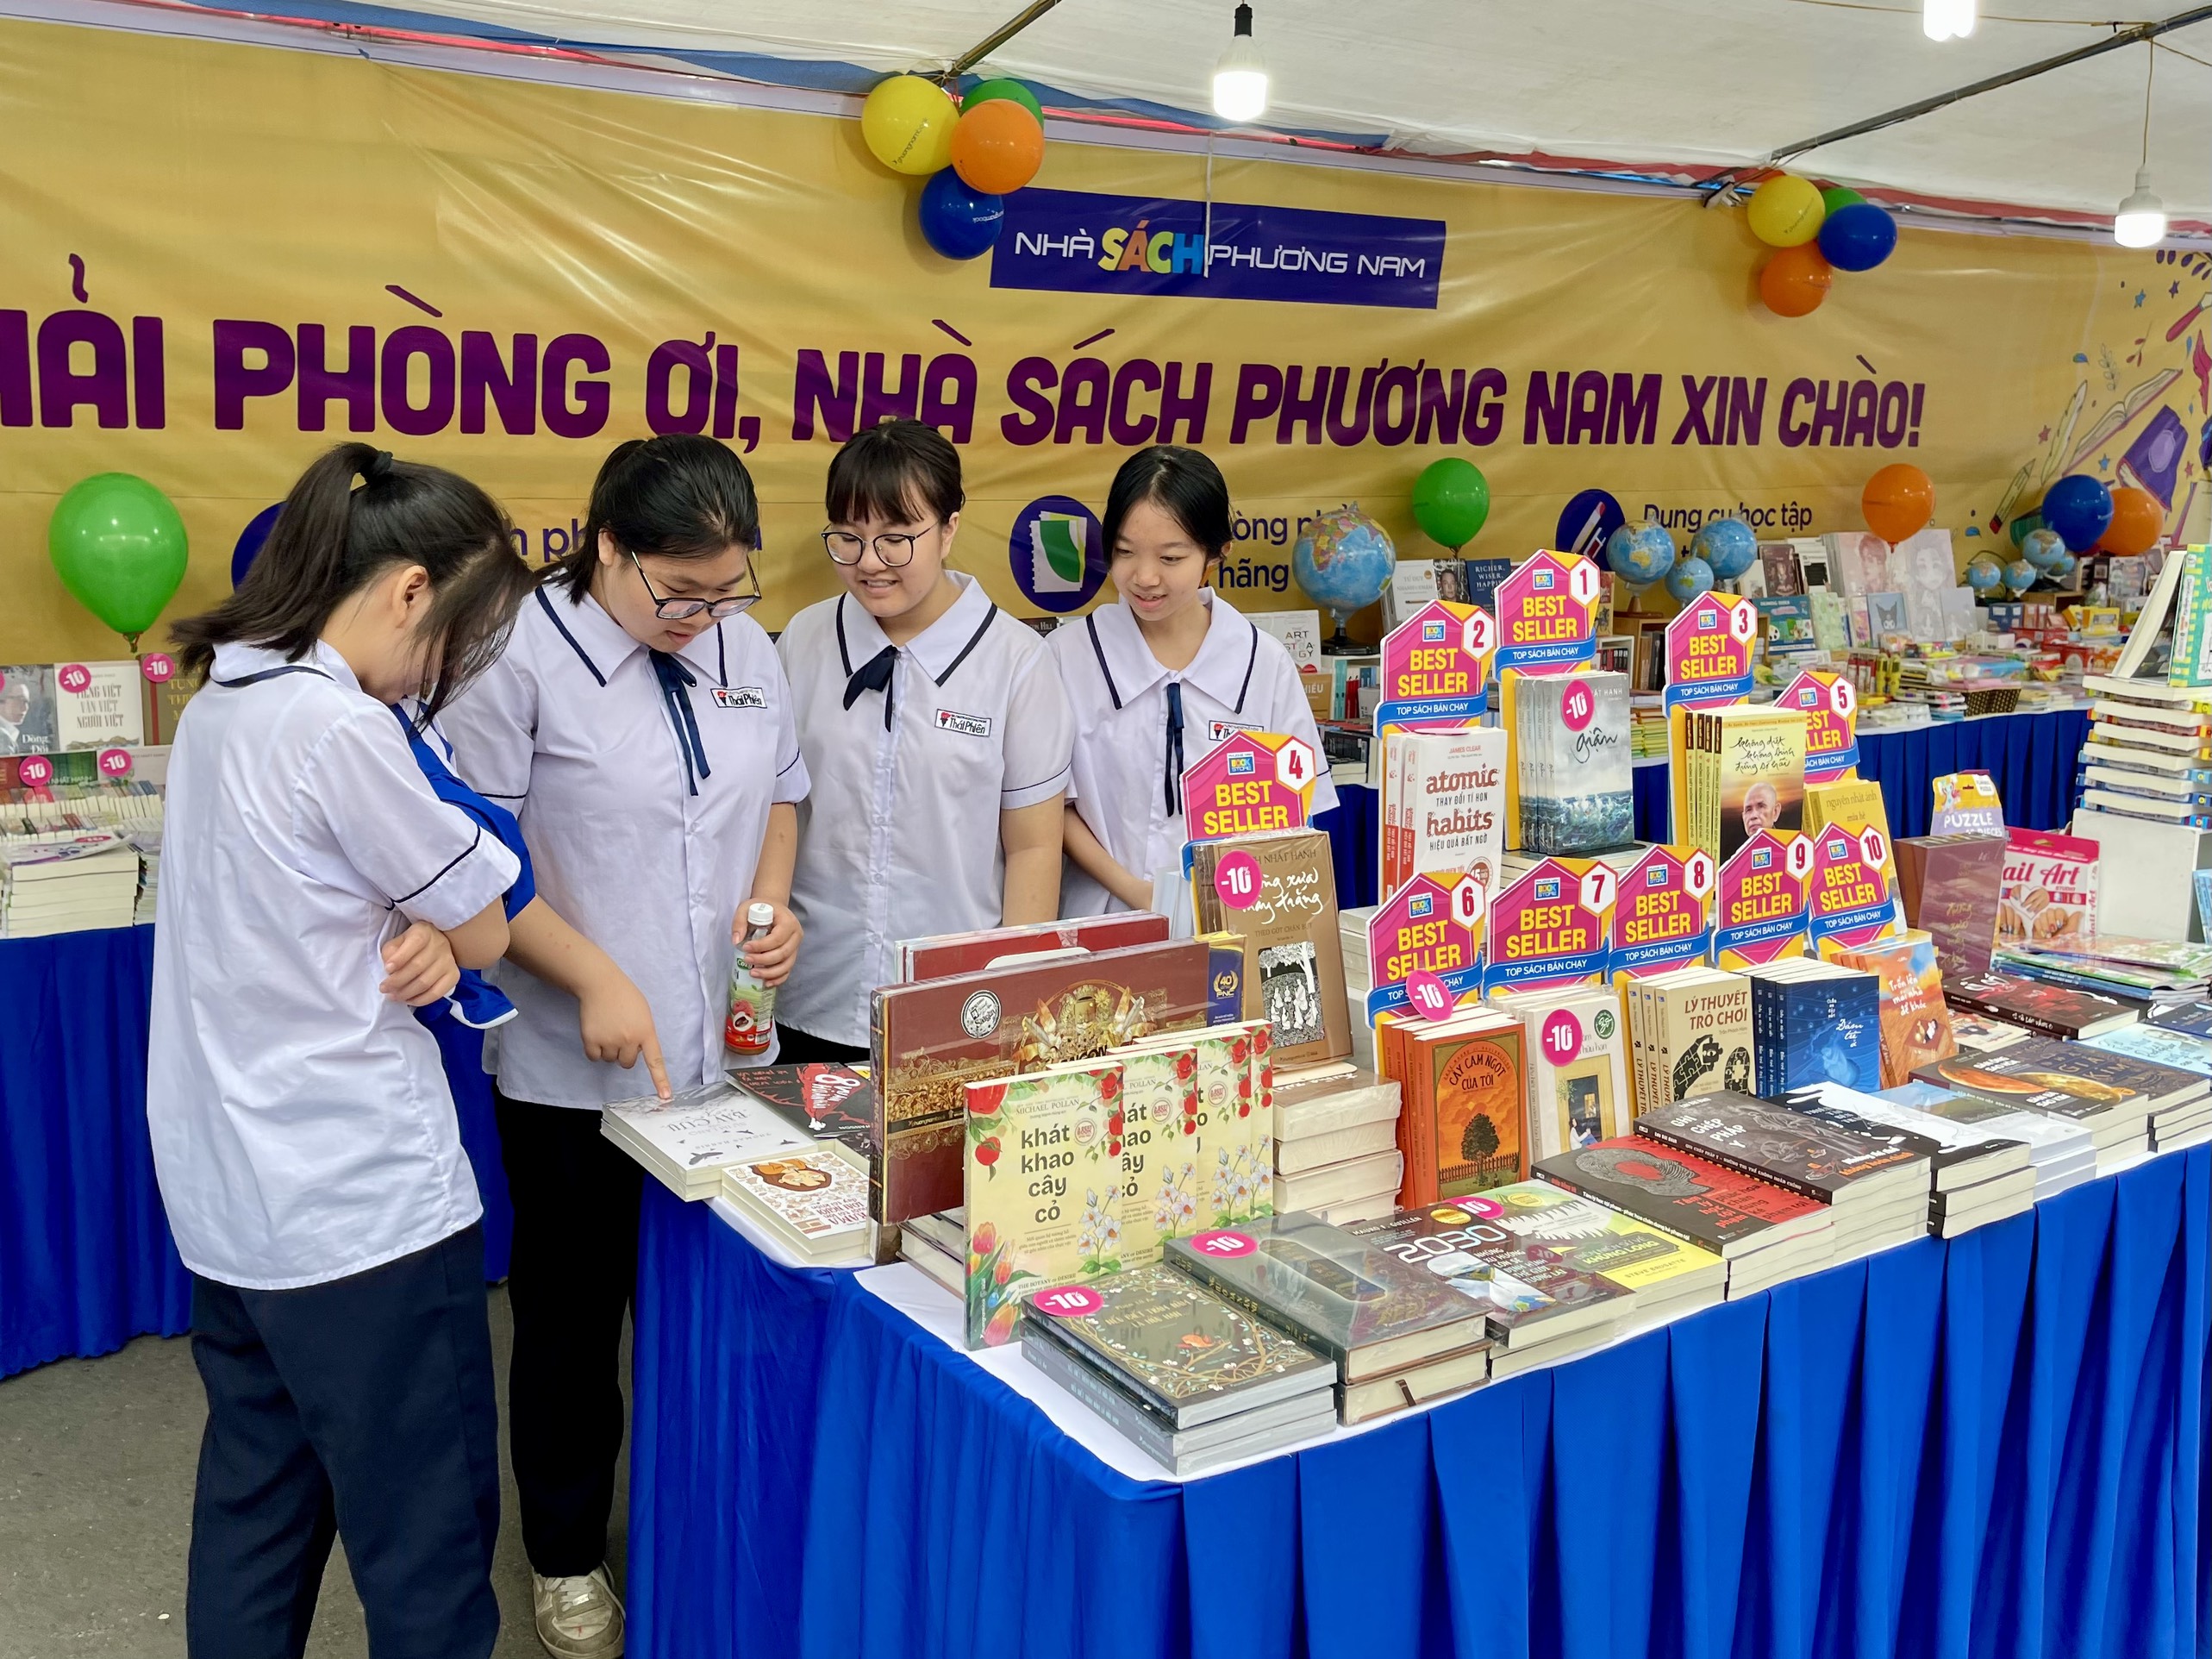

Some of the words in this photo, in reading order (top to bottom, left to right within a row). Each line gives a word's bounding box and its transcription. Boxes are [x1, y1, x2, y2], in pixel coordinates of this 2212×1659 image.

[1015, 229, 1095, 259] NHÀ
[1097, 219, 1205, 273] SÁCH
[1208, 243, 1349, 273] PHƯƠNG
[1356, 255, 1426, 279] NAM
[213, 284, 610, 438] PHÒNG
[792, 319, 979, 444] NHÀ
[1000, 328, 1214, 446] SÁCH
[1230, 358, 1508, 447] PHƯƠNG
[1522, 369, 1663, 446] NAM
[1672, 372, 1769, 447] XIN
[1778, 354, 1927, 448] CHÀO!
[1232, 510, 1287, 545] òng
[1781, 501, 1812, 532] tập
[1219, 558, 1289, 592] hãng
[1580, 569, 1587, 595] 1
[1522, 595, 1566, 617] BEST
[1513, 618, 1577, 642] SELLER
[1739, 609, 1748, 634] 3
[1473, 620, 1484, 648] 2
[1690, 635, 1728, 656] BEST
[1410, 648, 1459, 671] BEST
[1528, 648, 1546, 658] SÁCH
[1547, 648, 1560, 657] BÁN
[1561, 648, 1578, 656] CHẠY
[1681, 655, 1737, 679] SELLER
[1397, 672, 1468, 697] SELLER
[1694, 686, 1709, 695] SÁCH
[1710, 685, 1722, 693] BÁN
[1723, 683, 1738, 692] CHẠY
[1413, 704, 1433, 714] SÁCH
[1434, 702, 1448, 713] BÁN
[1449, 704, 1468, 712] CHẠY
[1837, 686, 1847, 709] 5
[1807, 711, 1829, 730] EST
[1806, 729, 1842, 752] LLER
[1289, 750, 1303, 779] 4
[1819, 757, 1829, 766] BÁN
[1831, 755, 1845, 764] CHẠY
[1427, 763, 1499, 794] atomic
[1215, 780, 1272, 806] BEST
[1436, 798, 1452, 806] THAY
[1454, 795, 1465, 804] ĐỔI
[1468, 792, 1473, 803] TÍ
[1476, 792, 1488, 802] HON
[1203, 805, 1289, 835] SELLER
[1427, 808, 1495, 837] habits
[1945, 812, 1993, 828] PUZZLE
[1430, 838, 1444, 851] HIỆU
[1447, 836, 1459, 848] QUẢ
[1461, 834, 1472, 846] BẤT
[1476, 833, 1487, 843] NGỜ
[1865, 835, 1883, 861] 10
[1796, 843, 1805, 869] 9
[1694, 861, 1704, 888] 8
[1741, 871, 1783, 898] BEST
[1824, 862, 1861, 887] BEST
[2003, 862, 2034, 881] ail
[2040, 863, 2079, 886] Art
[1592, 874, 1605, 904] 7
[1820, 883, 1878, 911] SELLER
[1462, 886, 1474, 917] 6
[1636, 890, 1680, 917] BEST
[1731, 893, 1792, 923] SELLER
[1521, 905, 1575, 931] BEST
[1625, 913, 1690, 942] SELLER
[1825, 919, 1838, 928] TOP
[1838, 916, 1853, 926] SÁCH
[1853, 912, 1865, 923] BÁN
[1866, 911, 1881, 922] CHẠY
[1398, 920, 1448, 952] BEST
[1506, 929, 1586, 958] SELLER
[1731, 932, 1743, 941] TOP
[1745, 928, 1761, 939] SÁCH
[1763, 926, 1775, 935] BÁN
[1776, 922, 1793, 932] CHẠY
[1387, 944, 1461, 980] SELLER
[1625, 952, 1639, 961] TOP
[1640, 948, 1659, 959] SÁCH
[1659, 946, 1673, 956] BÁN
[1674, 942, 1692, 953] CHẠY
[1220, 975, 1232, 985] 40
[1505, 967, 1522, 976] TOP
[1523, 963, 1545, 974] SÁCH
[1547, 961, 1564, 972] BÁN
[1565, 960, 1587, 970] CHẠY
[1907, 974, 1918, 986] lên
[1388, 990, 1403, 1000] TOP
[1444, 977, 1464, 987] CHẠY
[1684, 996, 1697, 1013] LÝ
[1701, 989, 1747, 1010] THUYẾT
[1690, 1011, 1713, 1030] TRÒ
[1717, 1009, 1747, 1024] CHƠI
[1449, 1064, 1465, 1086] CÂY
[1465, 1055, 1483, 1068] CAM
[1481, 1073, 1494, 1086] TÔI
[1130, 1080, 1156, 1089] POLLAN
[1015, 1105, 1048, 1115] MICHAEL
[1052, 1099, 1079, 1109] POLLAN
[1671, 1115, 1697, 1127] GHI
[1710, 1124, 1747, 1142] PHÁP
[1022, 1124, 1070, 1149] khát
[1022, 1151, 1074, 1174] khao
[1028, 1174, 1066, 1198] cây
[1035, 1199, 1060, 1223] cỏ
[1384, 1225, 1507, 1264] 2030
[1627, 1240, 1659, 1253] LONG
